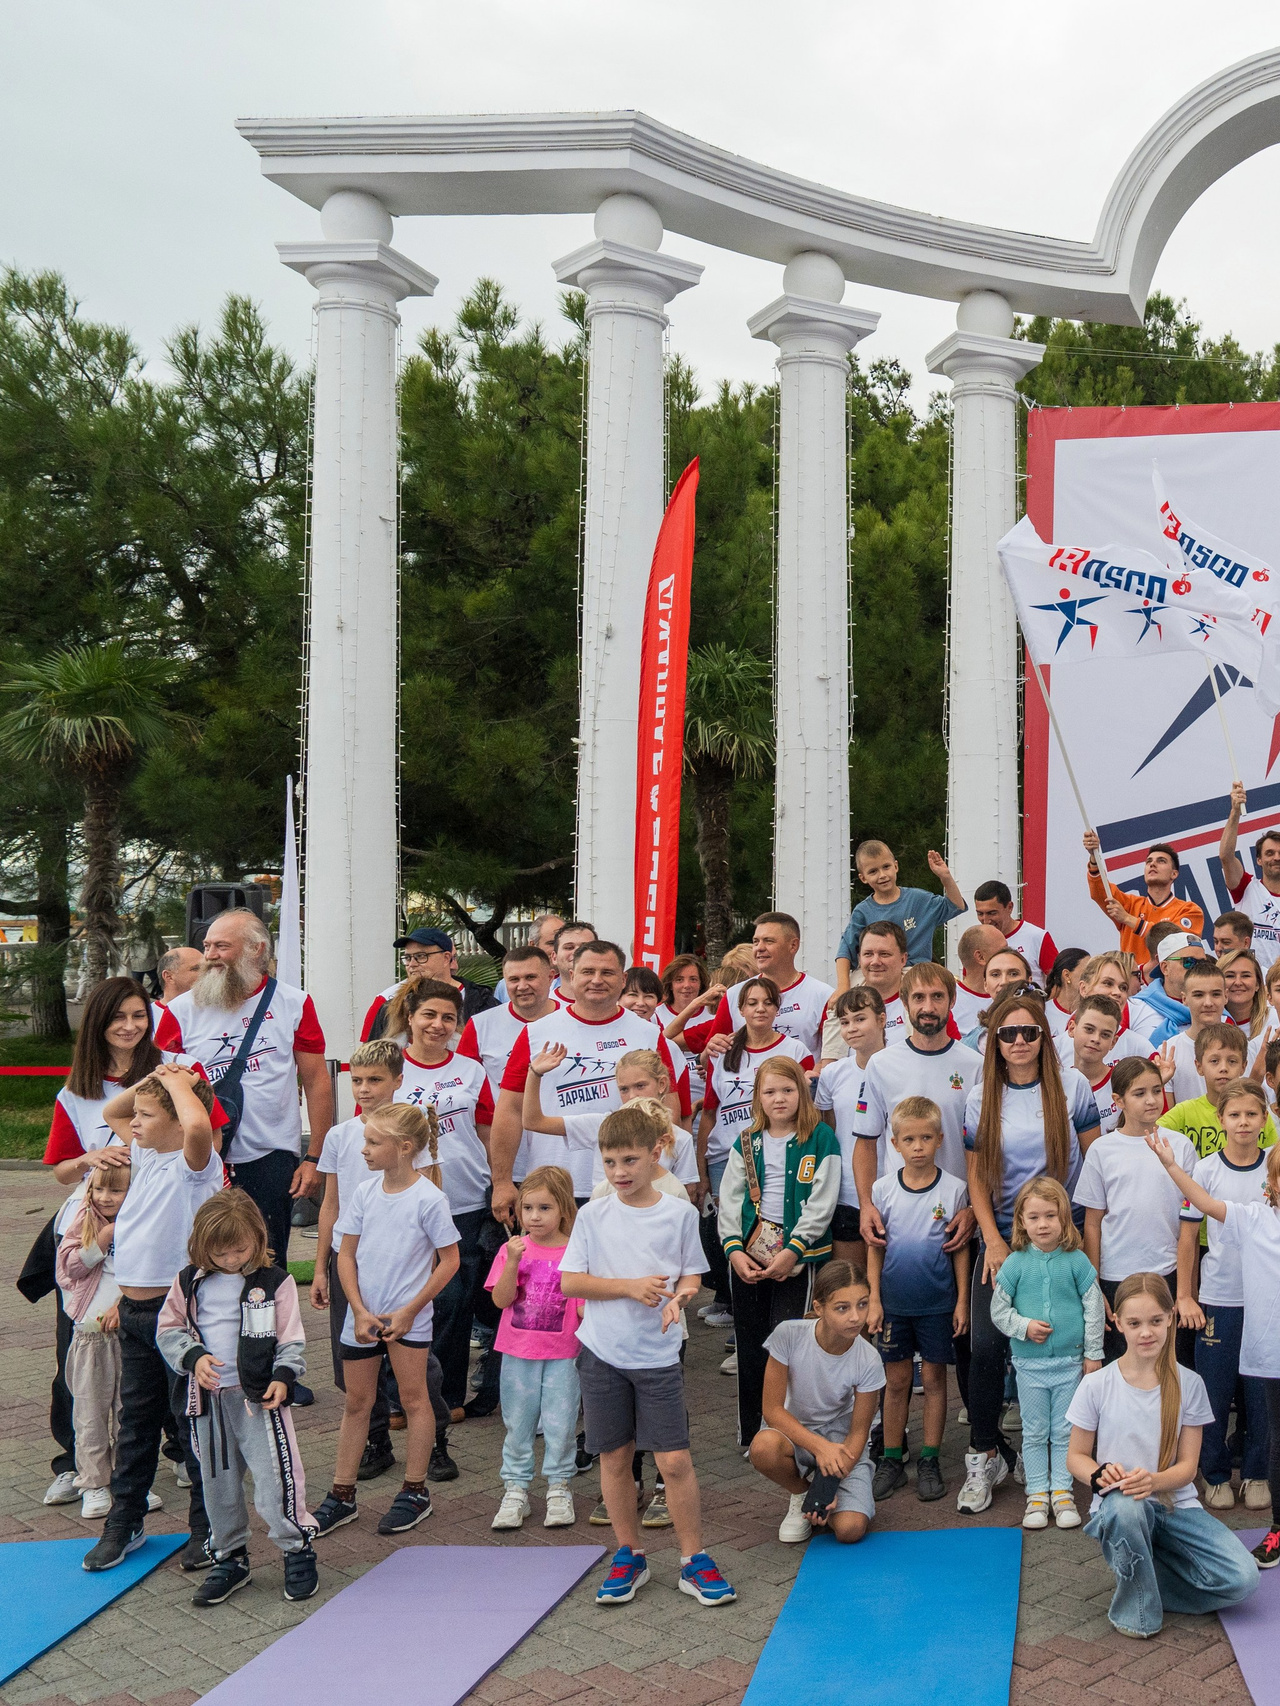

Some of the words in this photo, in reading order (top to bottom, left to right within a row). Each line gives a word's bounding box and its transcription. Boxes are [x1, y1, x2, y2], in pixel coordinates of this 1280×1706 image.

[596, 1040, 619, 1051] BOSCO
[557, 1083, 609, 1108] ЗАРЯДКА
[721, 1109, 752, 1126] ЗАРЯД
[797, 1155, 816, 1183] G
